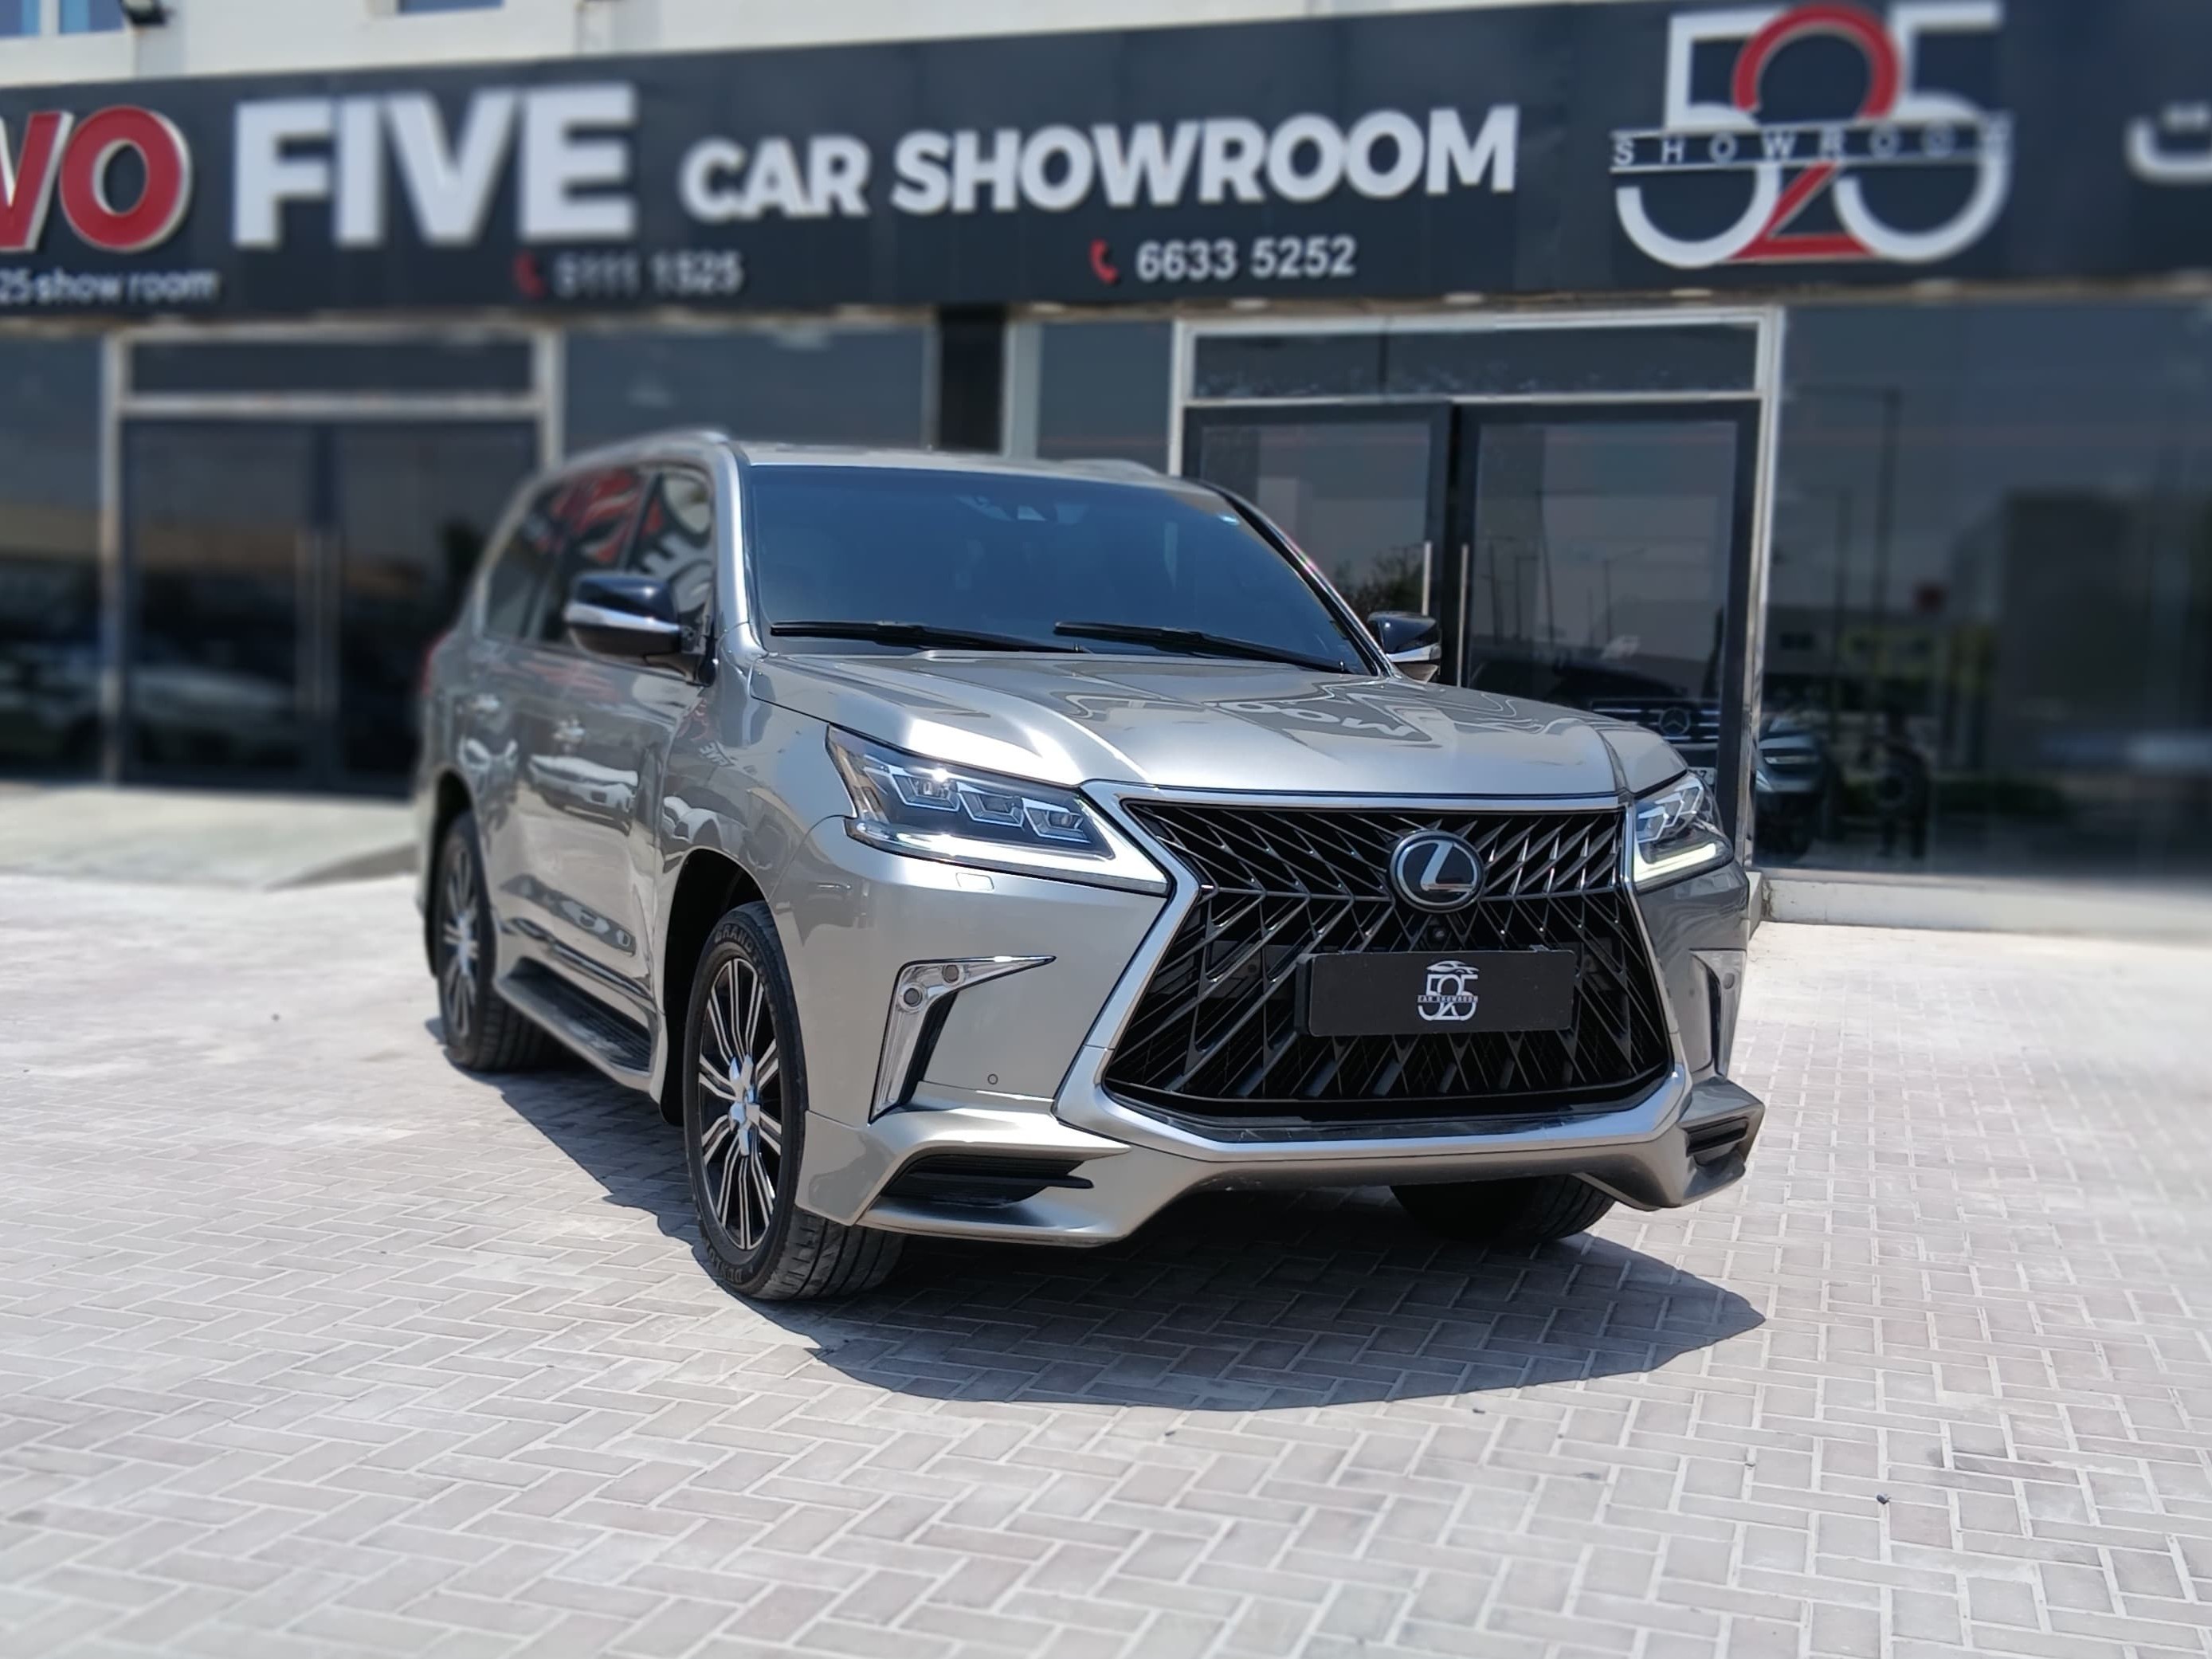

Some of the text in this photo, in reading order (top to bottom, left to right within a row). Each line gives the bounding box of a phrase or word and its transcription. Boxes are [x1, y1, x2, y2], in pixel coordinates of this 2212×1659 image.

[230, 82, 637, 248] FIVE
[680, 104, 1520, 222] CAR SHOWROOM
[1136, 234, 1356, 281] 6633 5252
[1418, 974, 1478, 1021] 525
